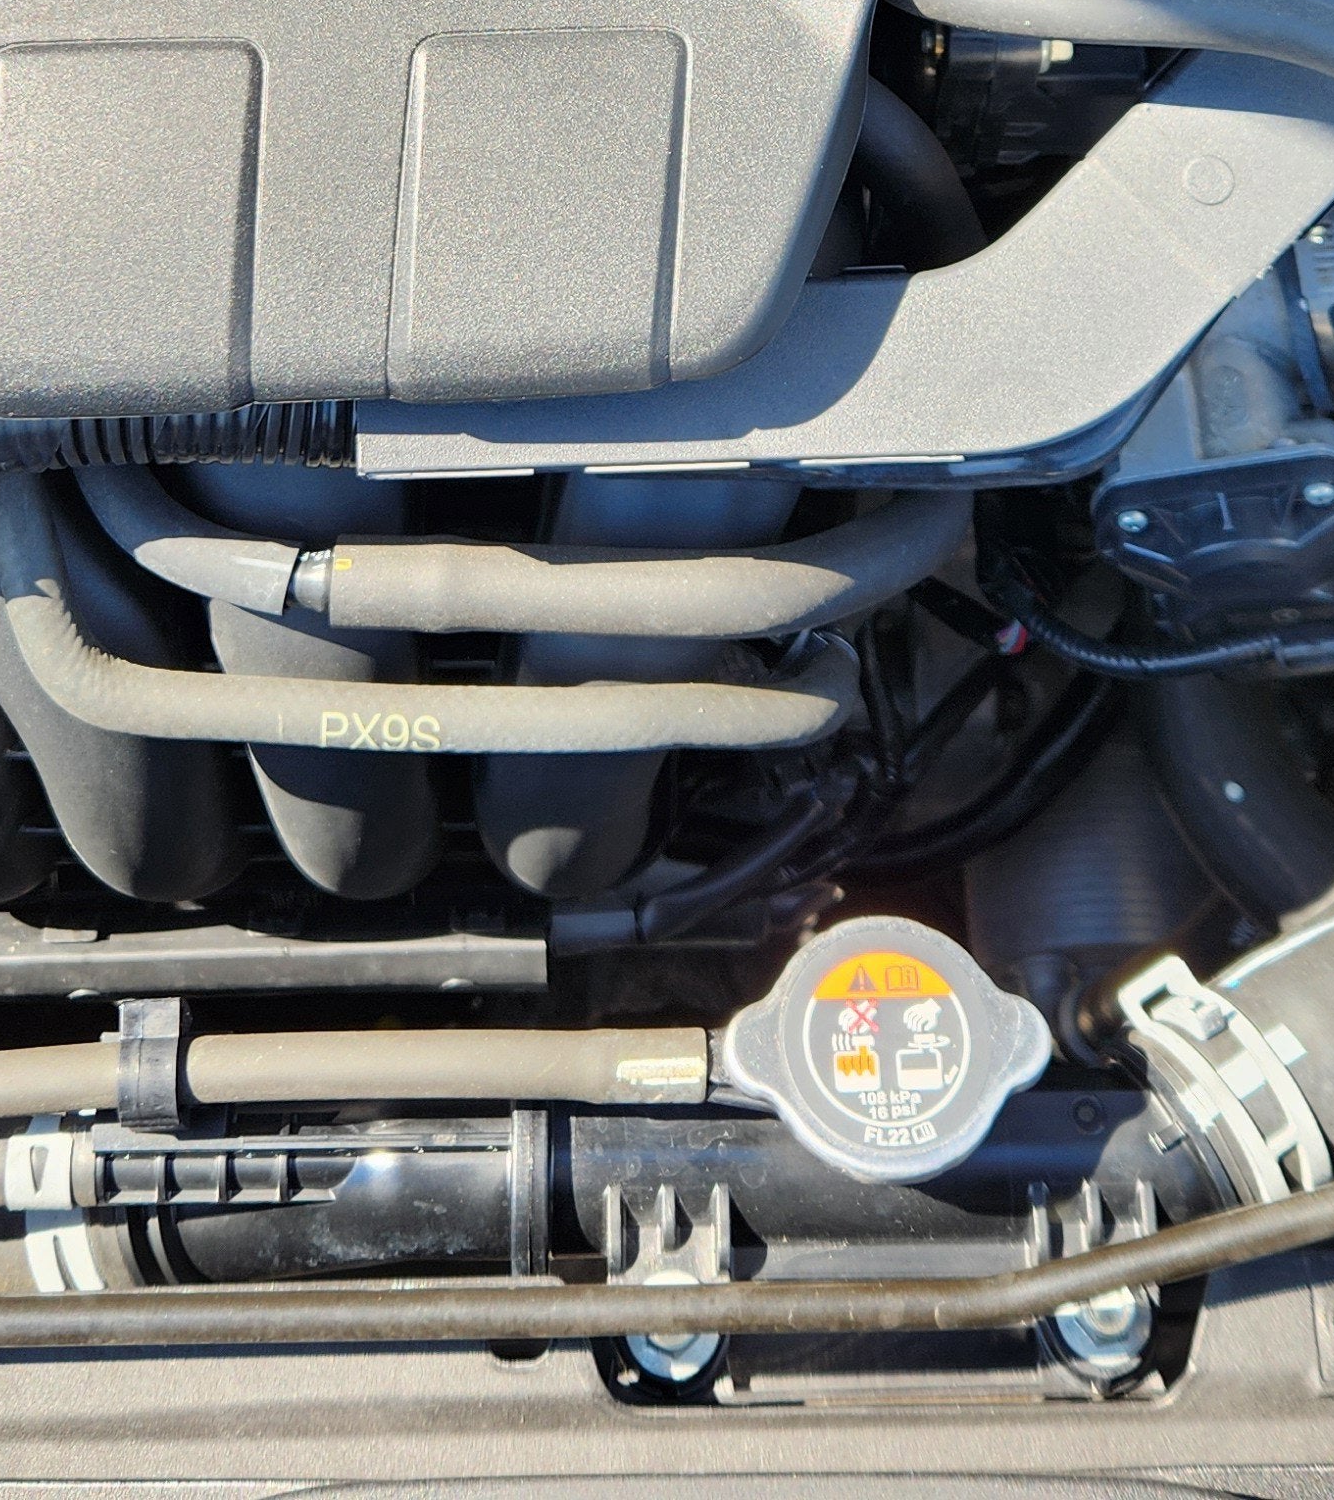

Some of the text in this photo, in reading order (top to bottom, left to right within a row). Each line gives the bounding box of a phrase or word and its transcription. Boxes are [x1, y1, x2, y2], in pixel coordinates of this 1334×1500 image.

[321, 711, 441, 751] PX9S
[858, 1089, 922, 1106] 108 kPa
[869, 1103, 917, 1120] 16 psi
[863, 1124, 912, 1147] FL22
